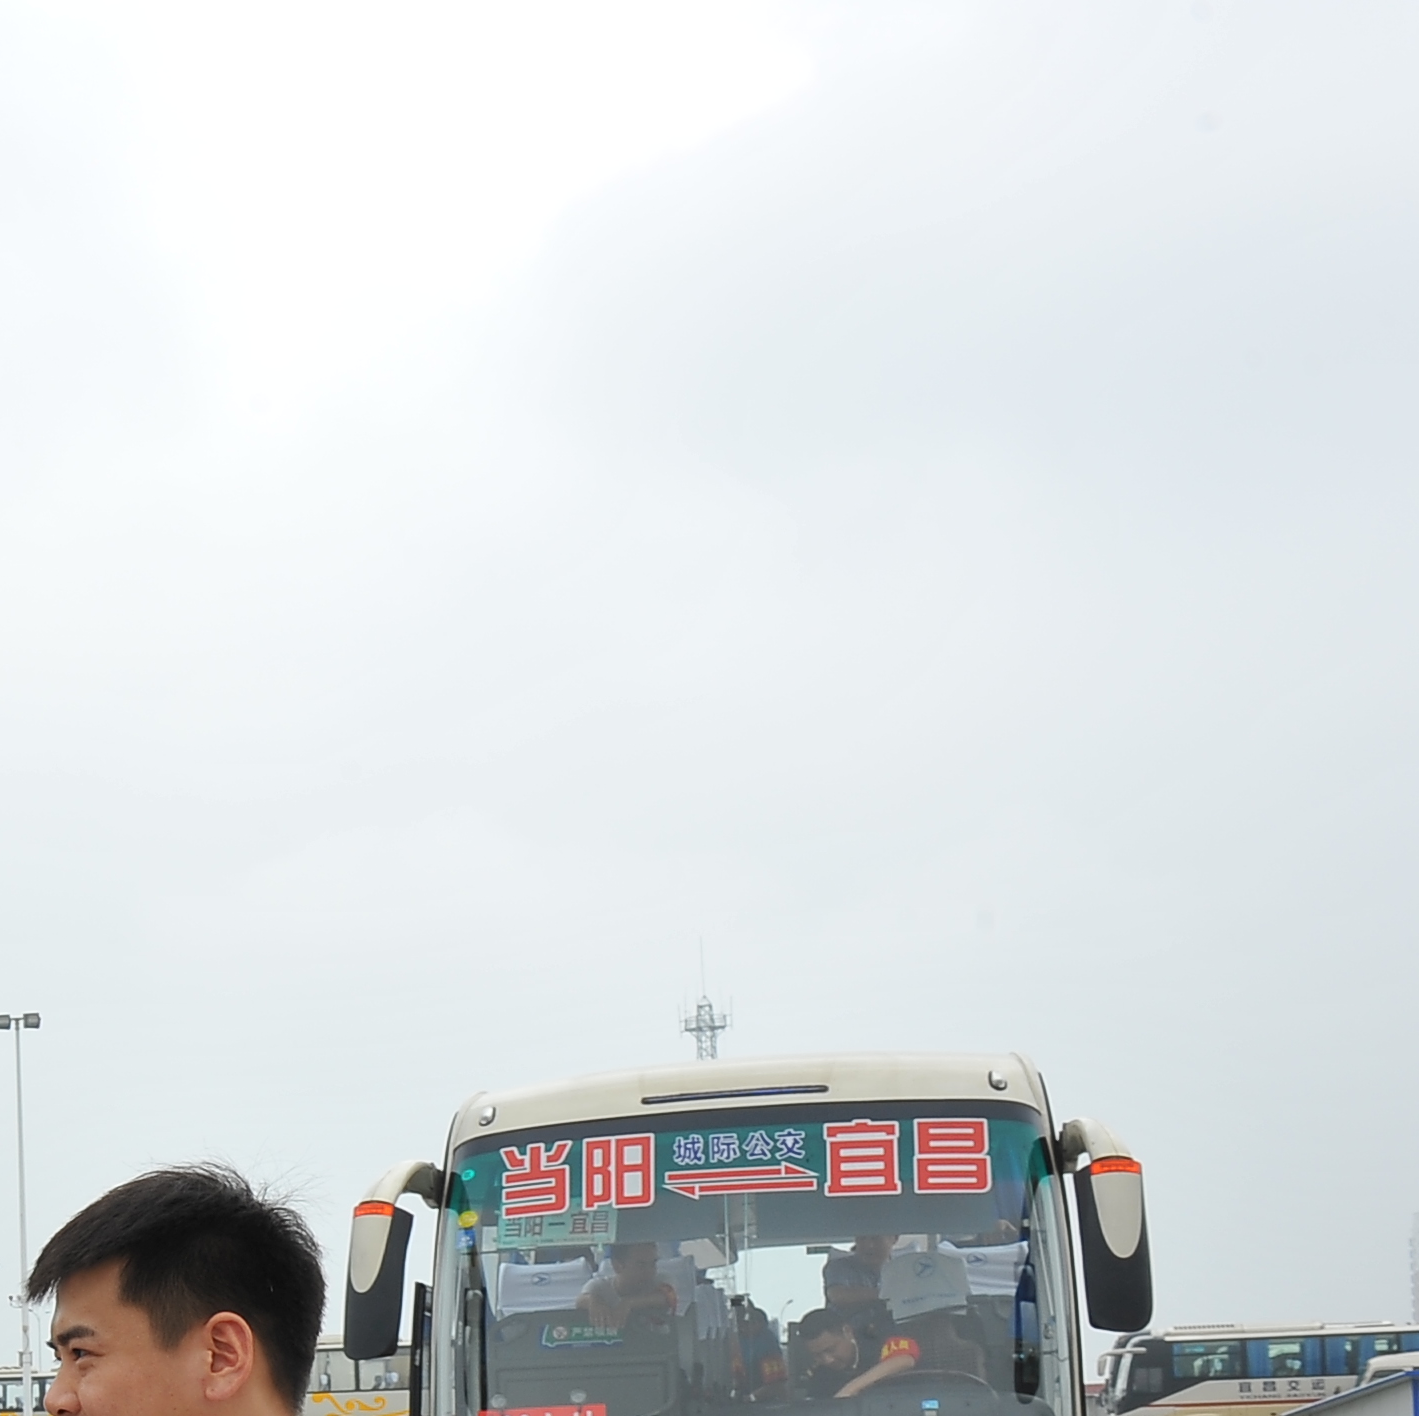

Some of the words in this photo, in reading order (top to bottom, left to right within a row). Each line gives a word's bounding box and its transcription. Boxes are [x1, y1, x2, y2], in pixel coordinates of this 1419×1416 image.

[499, 1132, 656, 1220] 当阳
[673, 1127, 806, 1166] 城际公交
[823, 1117, 992, 1197] 宜昌
